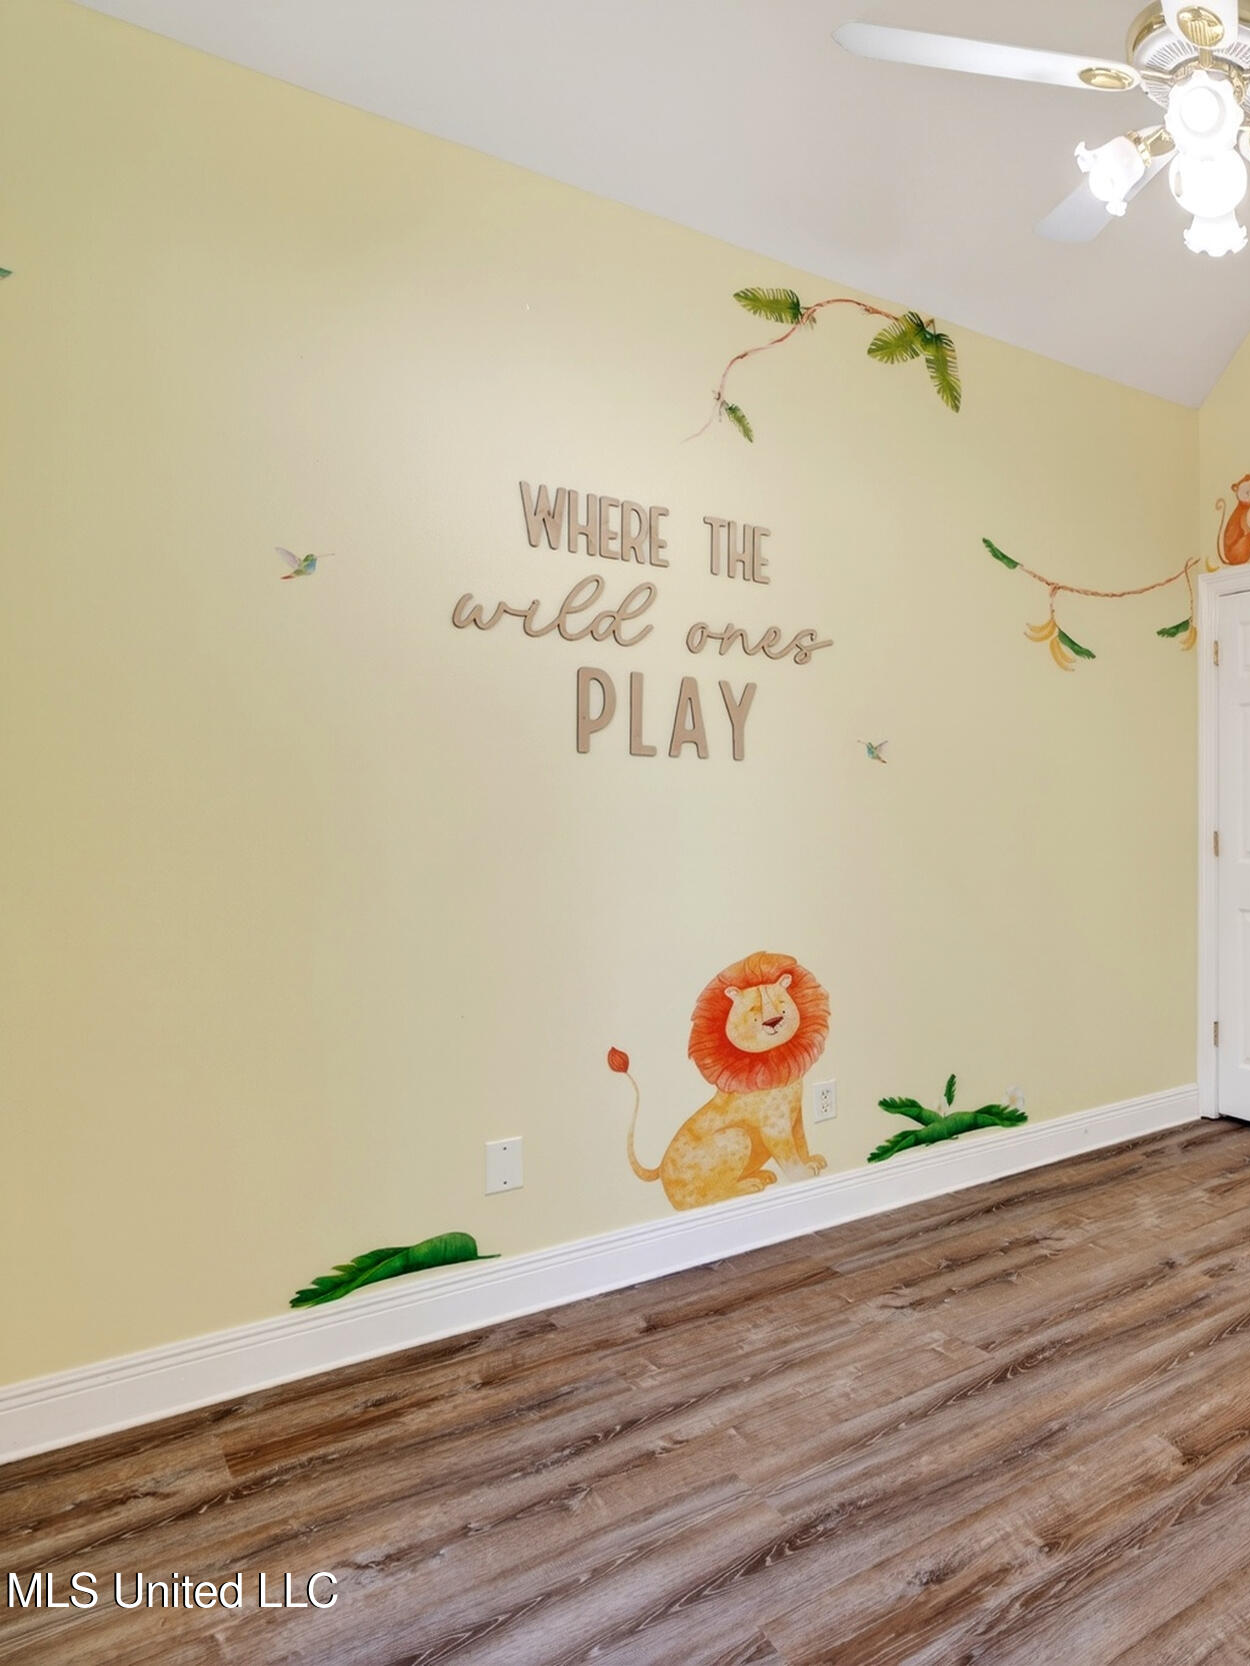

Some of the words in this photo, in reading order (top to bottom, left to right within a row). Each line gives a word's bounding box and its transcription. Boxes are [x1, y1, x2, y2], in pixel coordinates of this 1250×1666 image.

[519, 481, 669, 567] WHERE
[703, 516, 771, 584] THE
[452, 574, 657, 646] wild
[686, 621, 833, 664] ones
[576, 666, 757, 760] PLAY
